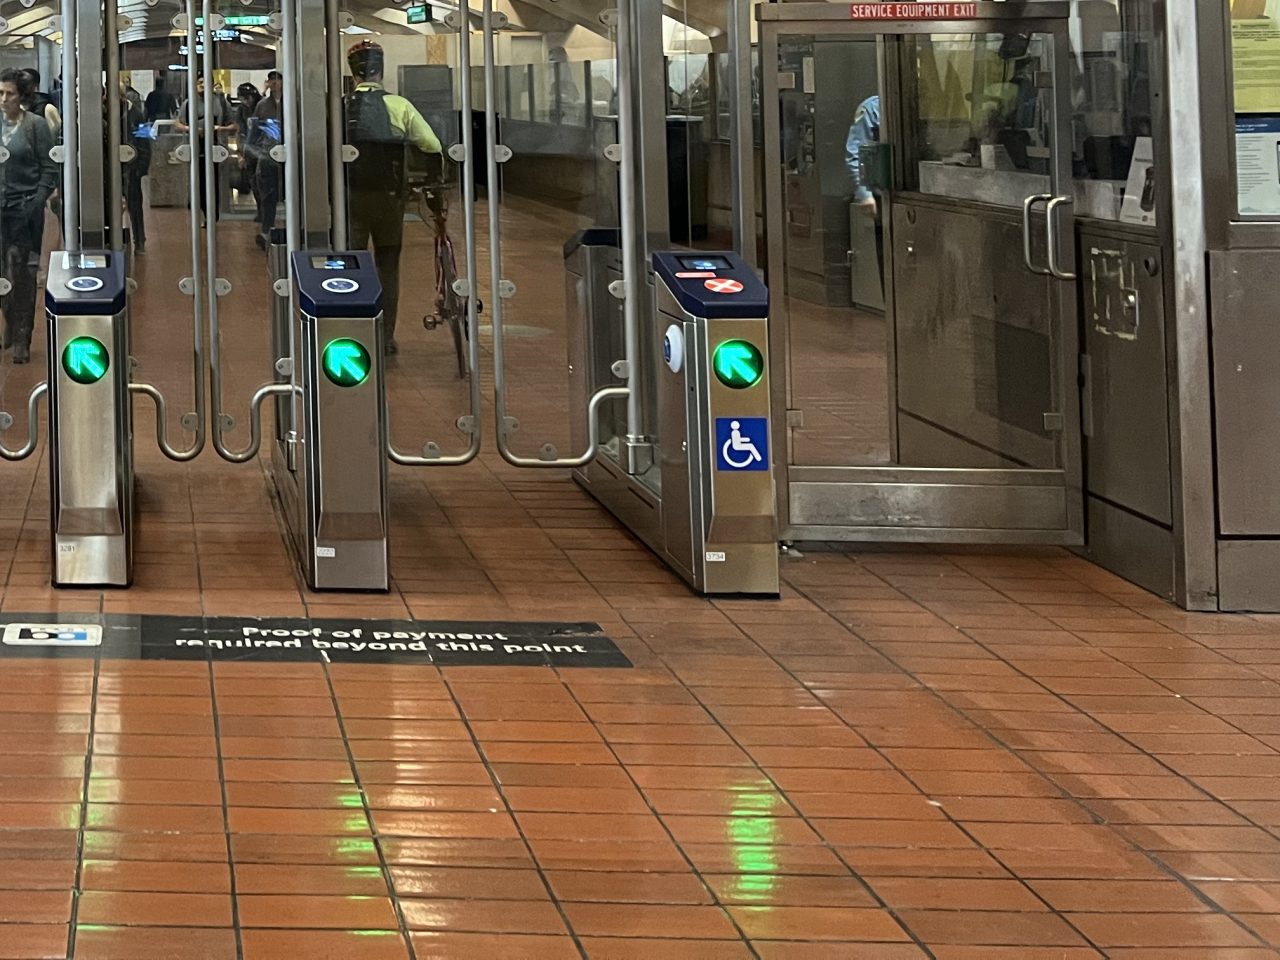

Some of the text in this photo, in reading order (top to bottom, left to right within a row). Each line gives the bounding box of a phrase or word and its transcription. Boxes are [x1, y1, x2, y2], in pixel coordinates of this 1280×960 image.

[852, 3, 975, 17] SERVICE EQUIPMENT EXIT
[242, 627, 508, 640] Proof of payment
[175, 638, 588, 653] required beyond this point
